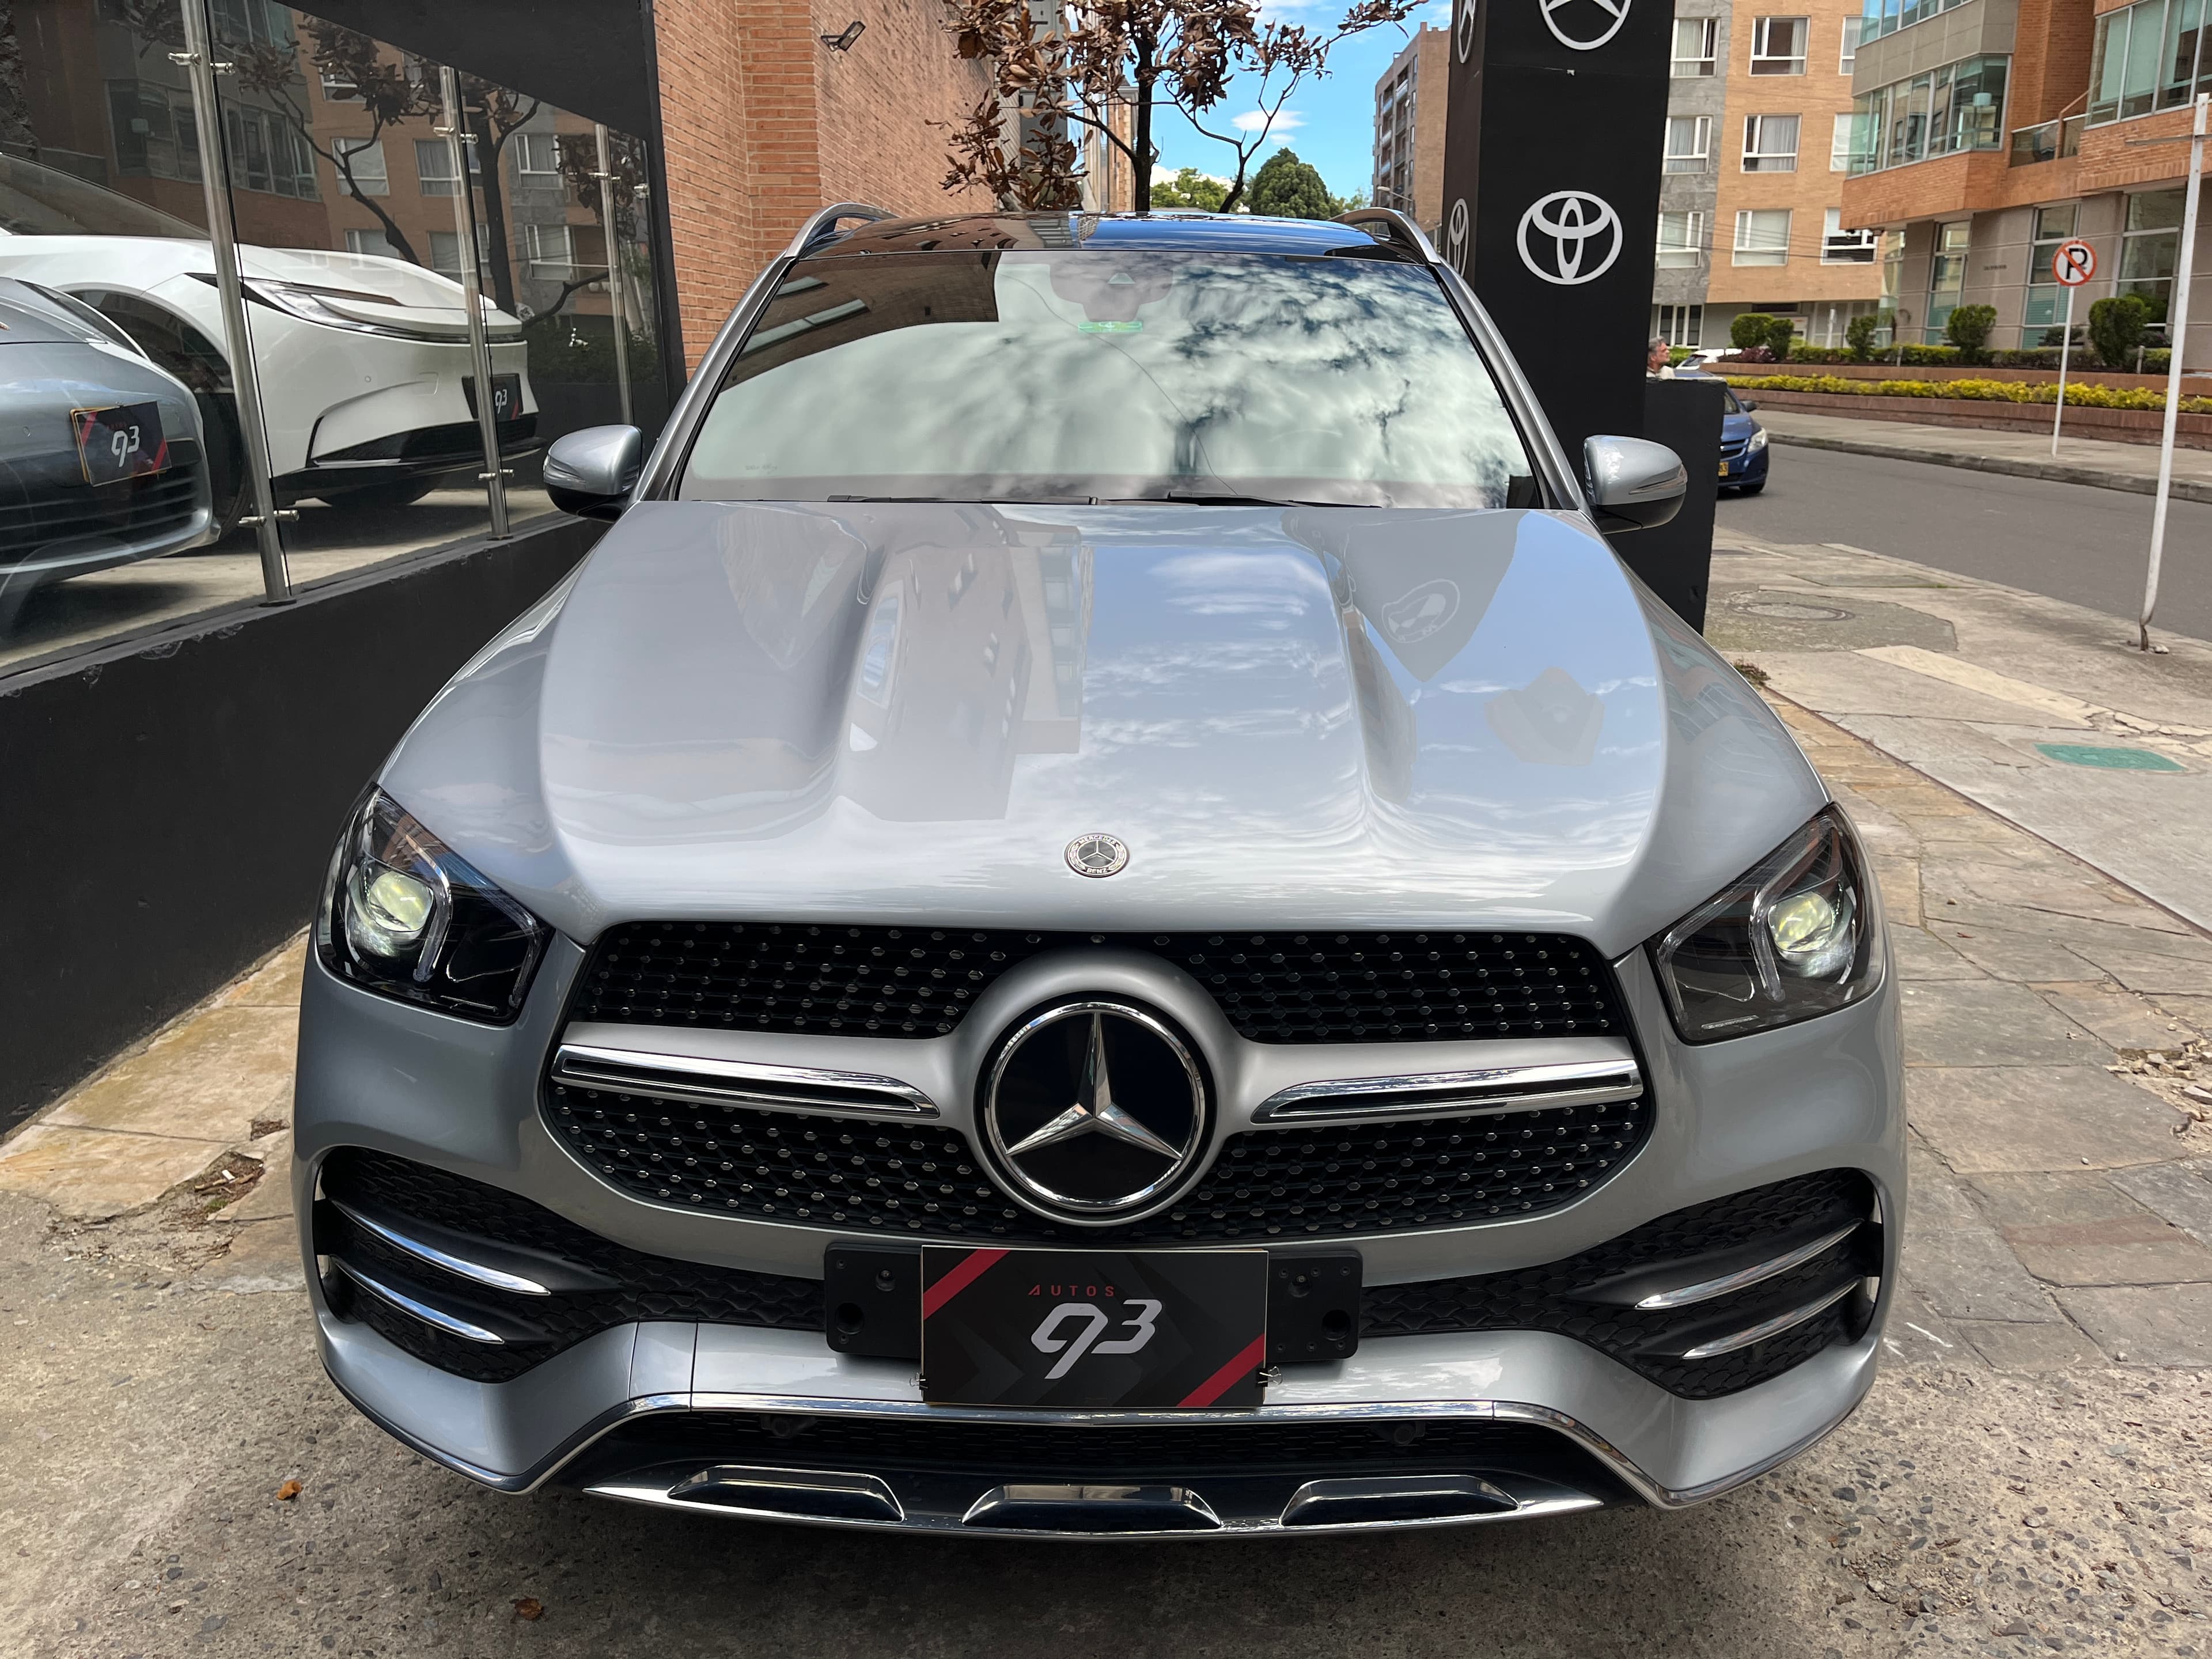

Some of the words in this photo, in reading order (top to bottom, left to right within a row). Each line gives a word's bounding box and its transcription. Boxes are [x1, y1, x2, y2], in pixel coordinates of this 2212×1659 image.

[495, 389, 507, 414] 93
[111, 425, 140, 468] 93
[1078, 835, 1116, 844] MERCEDES
[1028, 1285, 1115, 1297] AUTOS
[1031, 1299, 1162, 1380] 93
